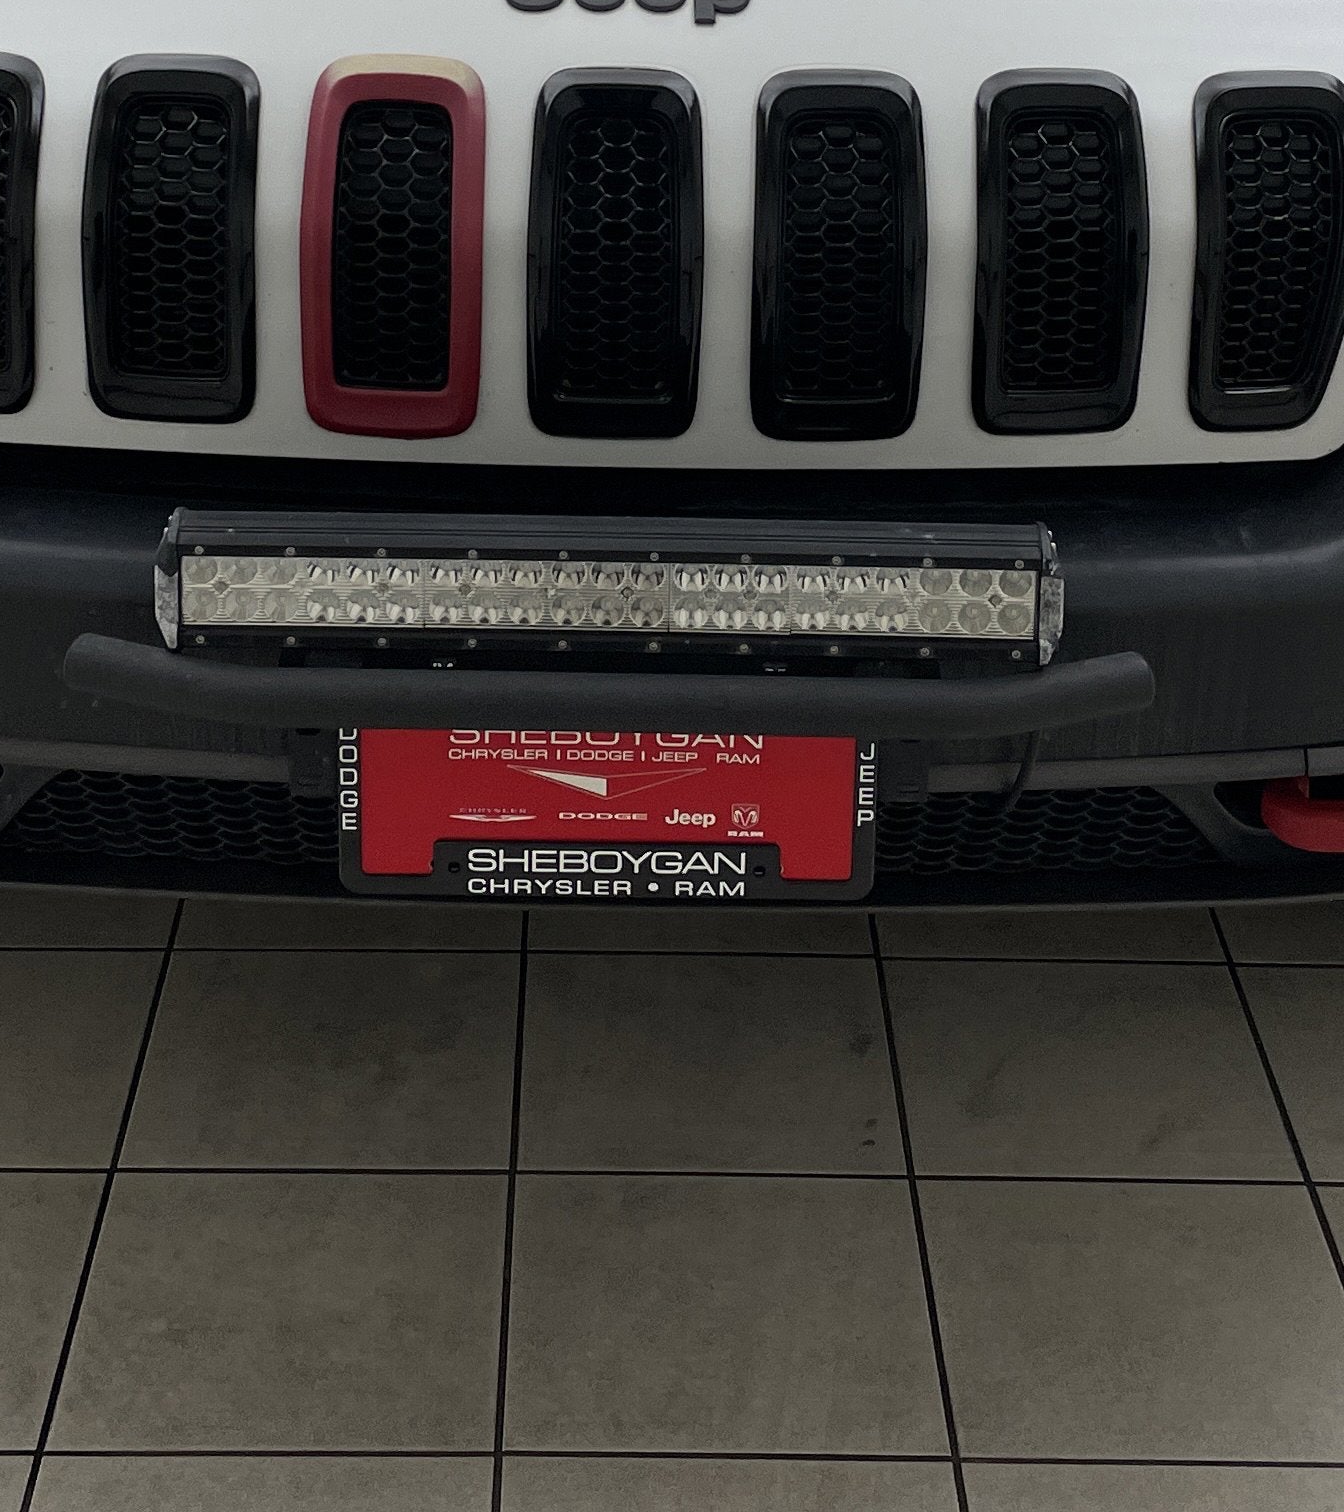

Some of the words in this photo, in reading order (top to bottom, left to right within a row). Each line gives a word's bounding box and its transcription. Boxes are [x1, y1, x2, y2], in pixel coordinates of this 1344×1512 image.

[448, 748, 548, 760] CHRYSLER
[566, 749, 634, 762] DODGE
[652, 751, 698, 763] JEEP
[716, 752, 760, 764] RAM
[857, 742, 875, 827] JEEP
[559, 812, 648, 821] DODGE
[665, 808, 716, 828] Jeep
[467, 848, 747, 875] SHEBOYGAN
[467, 879, 632, 895] CHRYSLER
[675, 881, 745, 897] RAM
